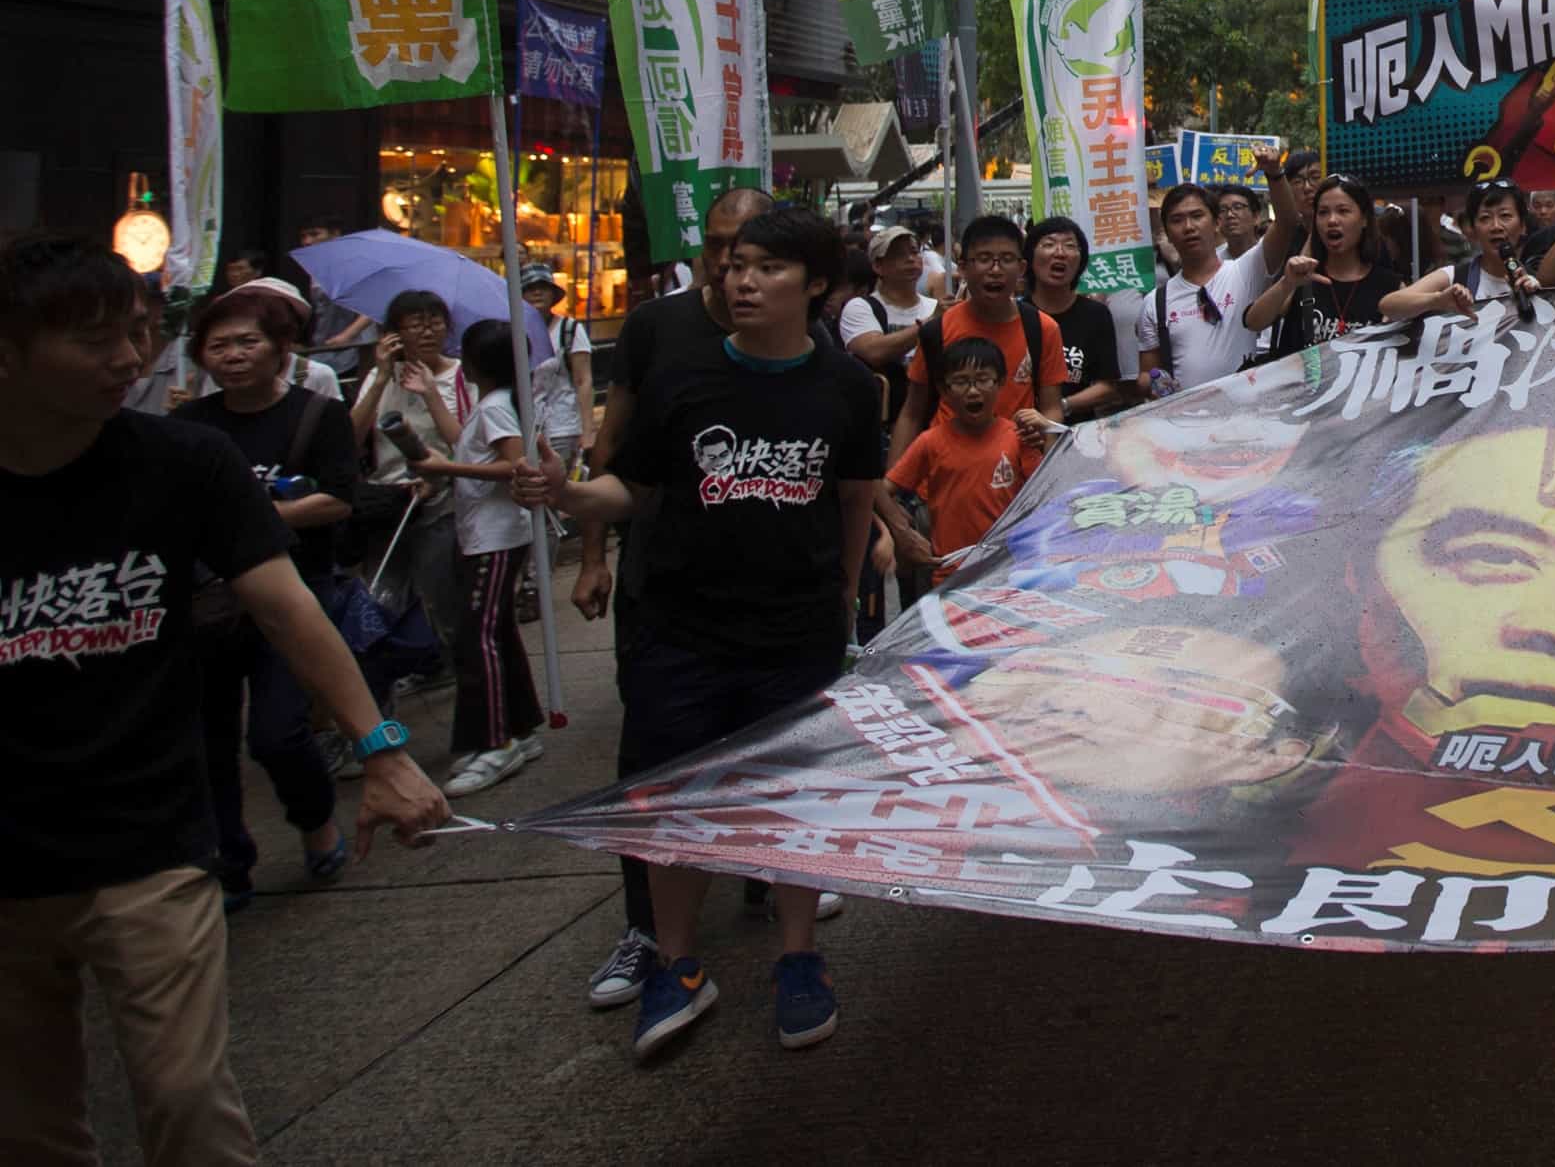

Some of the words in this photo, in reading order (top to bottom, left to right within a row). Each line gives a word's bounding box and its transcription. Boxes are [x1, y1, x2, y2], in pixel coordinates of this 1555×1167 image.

[734, 436, 830, 477] 快落台
[699, 474, 734, 504] CY
[1, 550, 169, 630] 快落台
